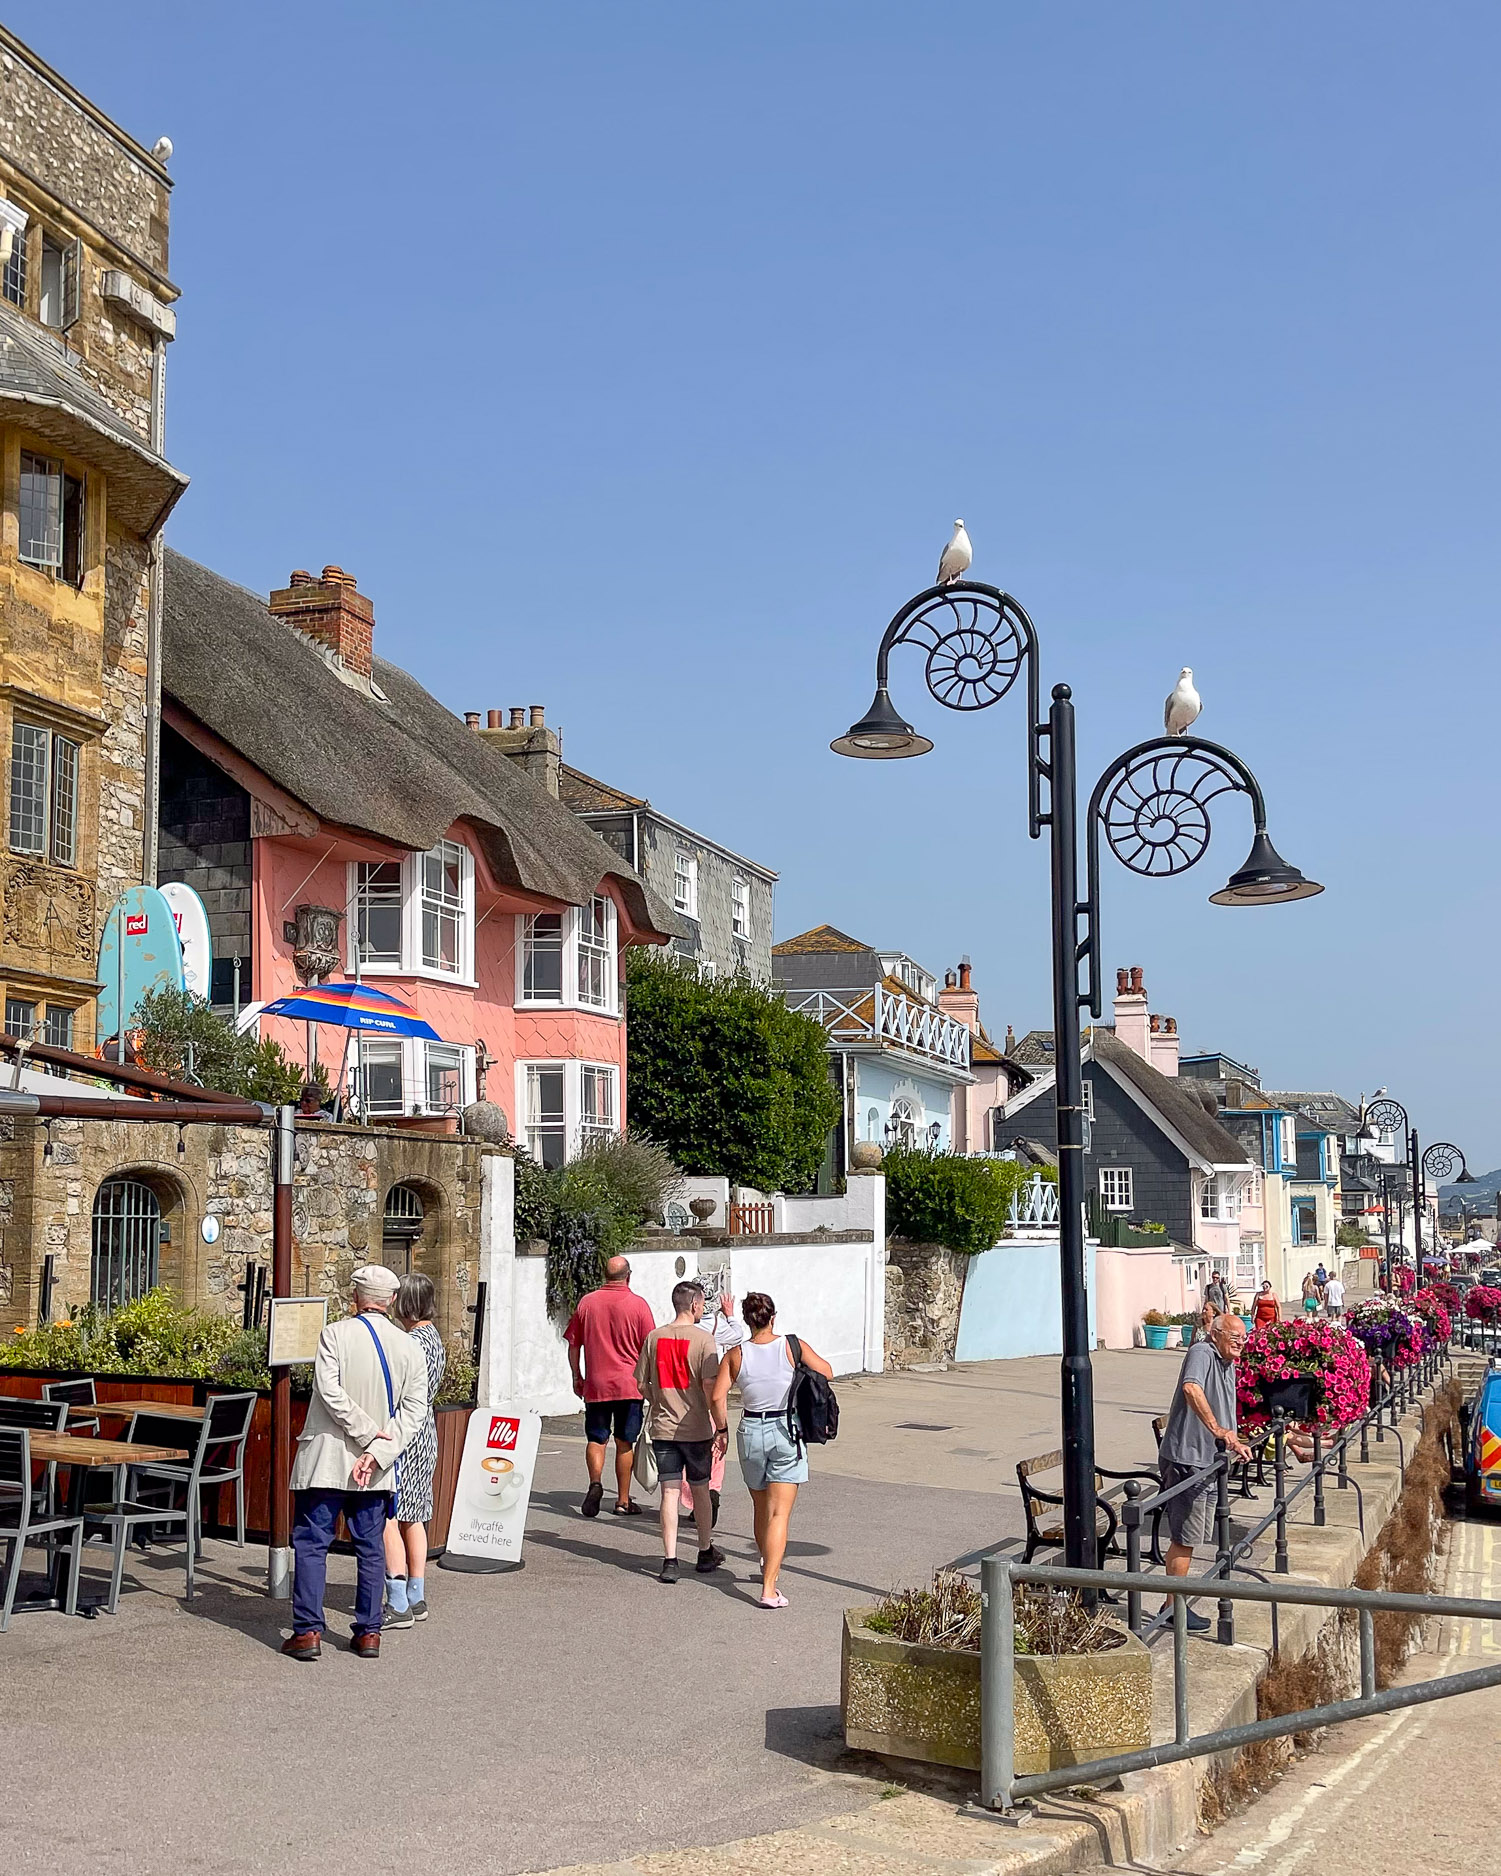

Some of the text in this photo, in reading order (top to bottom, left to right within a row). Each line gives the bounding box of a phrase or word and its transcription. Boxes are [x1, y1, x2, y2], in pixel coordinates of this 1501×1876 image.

[128, 914, 146, 930] red
[360, 1017, 396, 1028] RIP CURL
[489, 1421, 516, 1447] illy
[458, 1532, 512, 1547] served here
